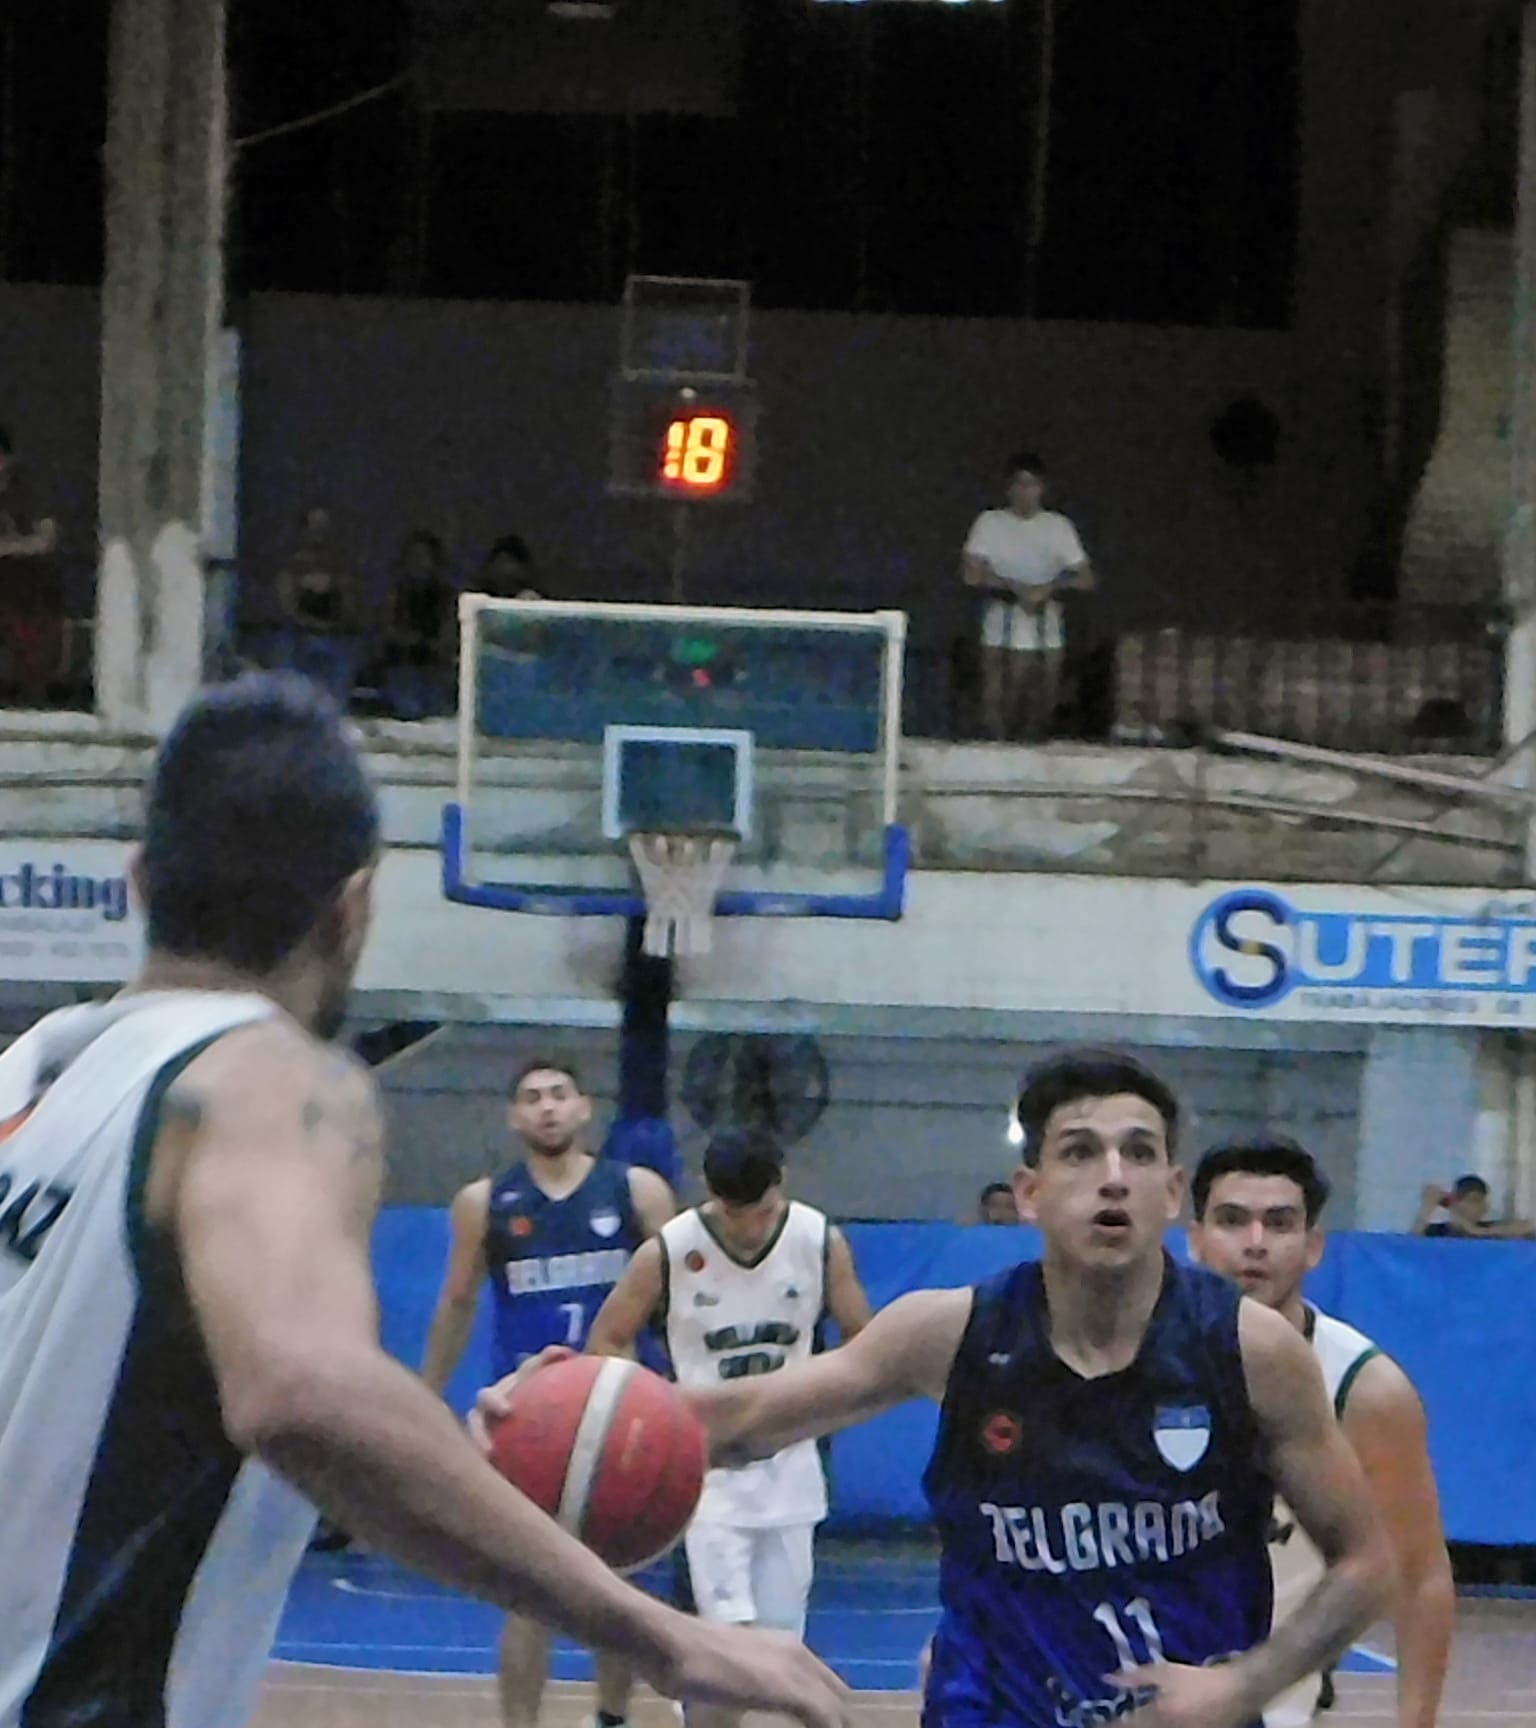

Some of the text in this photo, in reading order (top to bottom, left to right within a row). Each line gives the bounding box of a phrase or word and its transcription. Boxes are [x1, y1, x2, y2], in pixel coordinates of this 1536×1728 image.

[664, 416, 728, 484] 18
[559, 1303, 584, 1344] 7
[1092, 1596, 1168, 1674] 11
